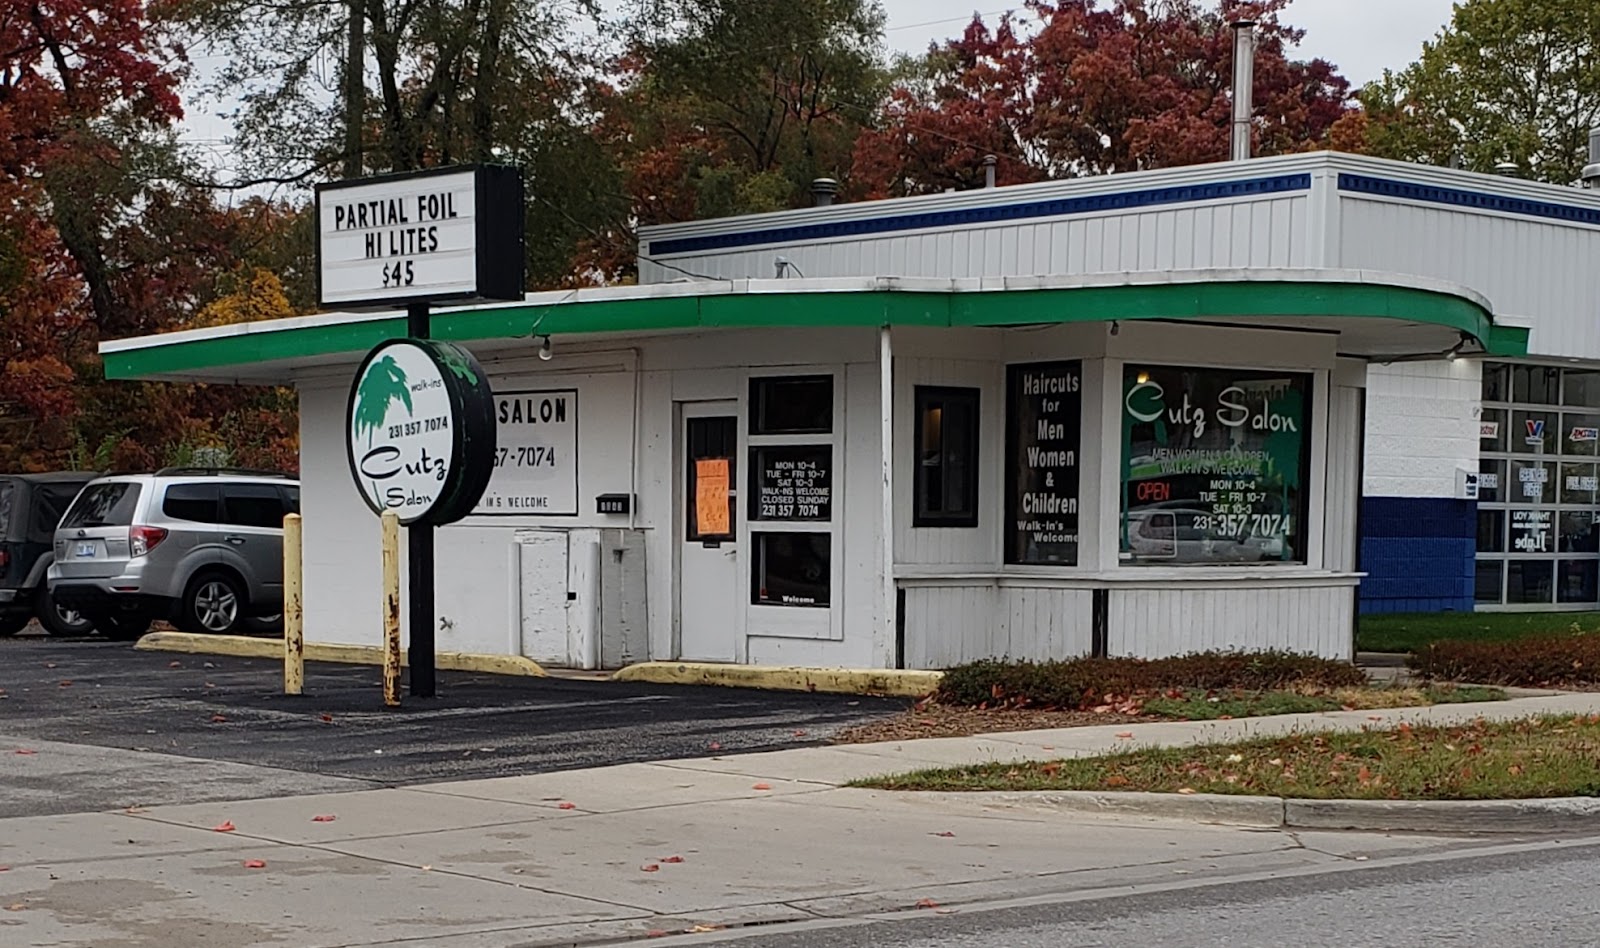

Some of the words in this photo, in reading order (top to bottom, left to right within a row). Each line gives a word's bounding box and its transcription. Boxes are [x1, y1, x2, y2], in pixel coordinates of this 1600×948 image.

[336, 198, 408, 230] PARTIAL
[418, 192, 457, 222] FOIL
[366, 232, 381, 258] HI
[390, 226, 438, 256] LITES
[382, 260, 414, 288] $45
[411, 378, 442, 392] walk-ins
[1023, 372, 1079, 395] Haircuts
[498, 398, 566, 424] SALON
[1042, 398, 1060, 413] for
[1126, 381, 1206, 438] Cutz
[1216, 386, 1297, 432] Salon
[388, 425, 402, 438] 231
[405, 422, 421, 436] 357
[425, 416, 448, 432] 7074
[1038, 420, 1064, 440] Men
[361, 446, 446, 481] Cutz
[775, 461, 794, 470] MON
[797, 461, 816, 470] 10-4
[1027, 447, 1074, 468] Women
[766, 470, 782, 478] TUE
[792, 470, 805, 478] FRI
[808, 470, 826, 478] 10-7
[777, 478, 792, 486] SAT
[795, 478, 814, 486] 10-3
[1046, 472, 1054, 487] &
[796, 487, 830, 496] WELCOME
[1137, 482, 1170, 500] OPEN
[1210, 480, 1232, 490] MON
[1235, 480, 1256, 490] 10-4
[385, 488, 432, 508] Salon
[508, 497, 548, 508] WELCOME
[761, 496, 794, 504] CLOSED
[796, 496, 830, 504] SUNDAY
[1022, 492, 1076, 514] Children
[1200, 492, 1217, 502] TUE
[1228, 492, 1244, 502] FRI
[1246, 492, 1266, 502] 10-7
[762, 504, 776, 516] 231
[778, 504, 794, 516] 357
[798, 504, 818, 516] 7074
[1212, 504, 1230, 514] SAT
[1232, 504, 1252, 514] 10-3
[1251, 514, 1290, 536] 7074
[782, 595, 815, 604] Welcome
